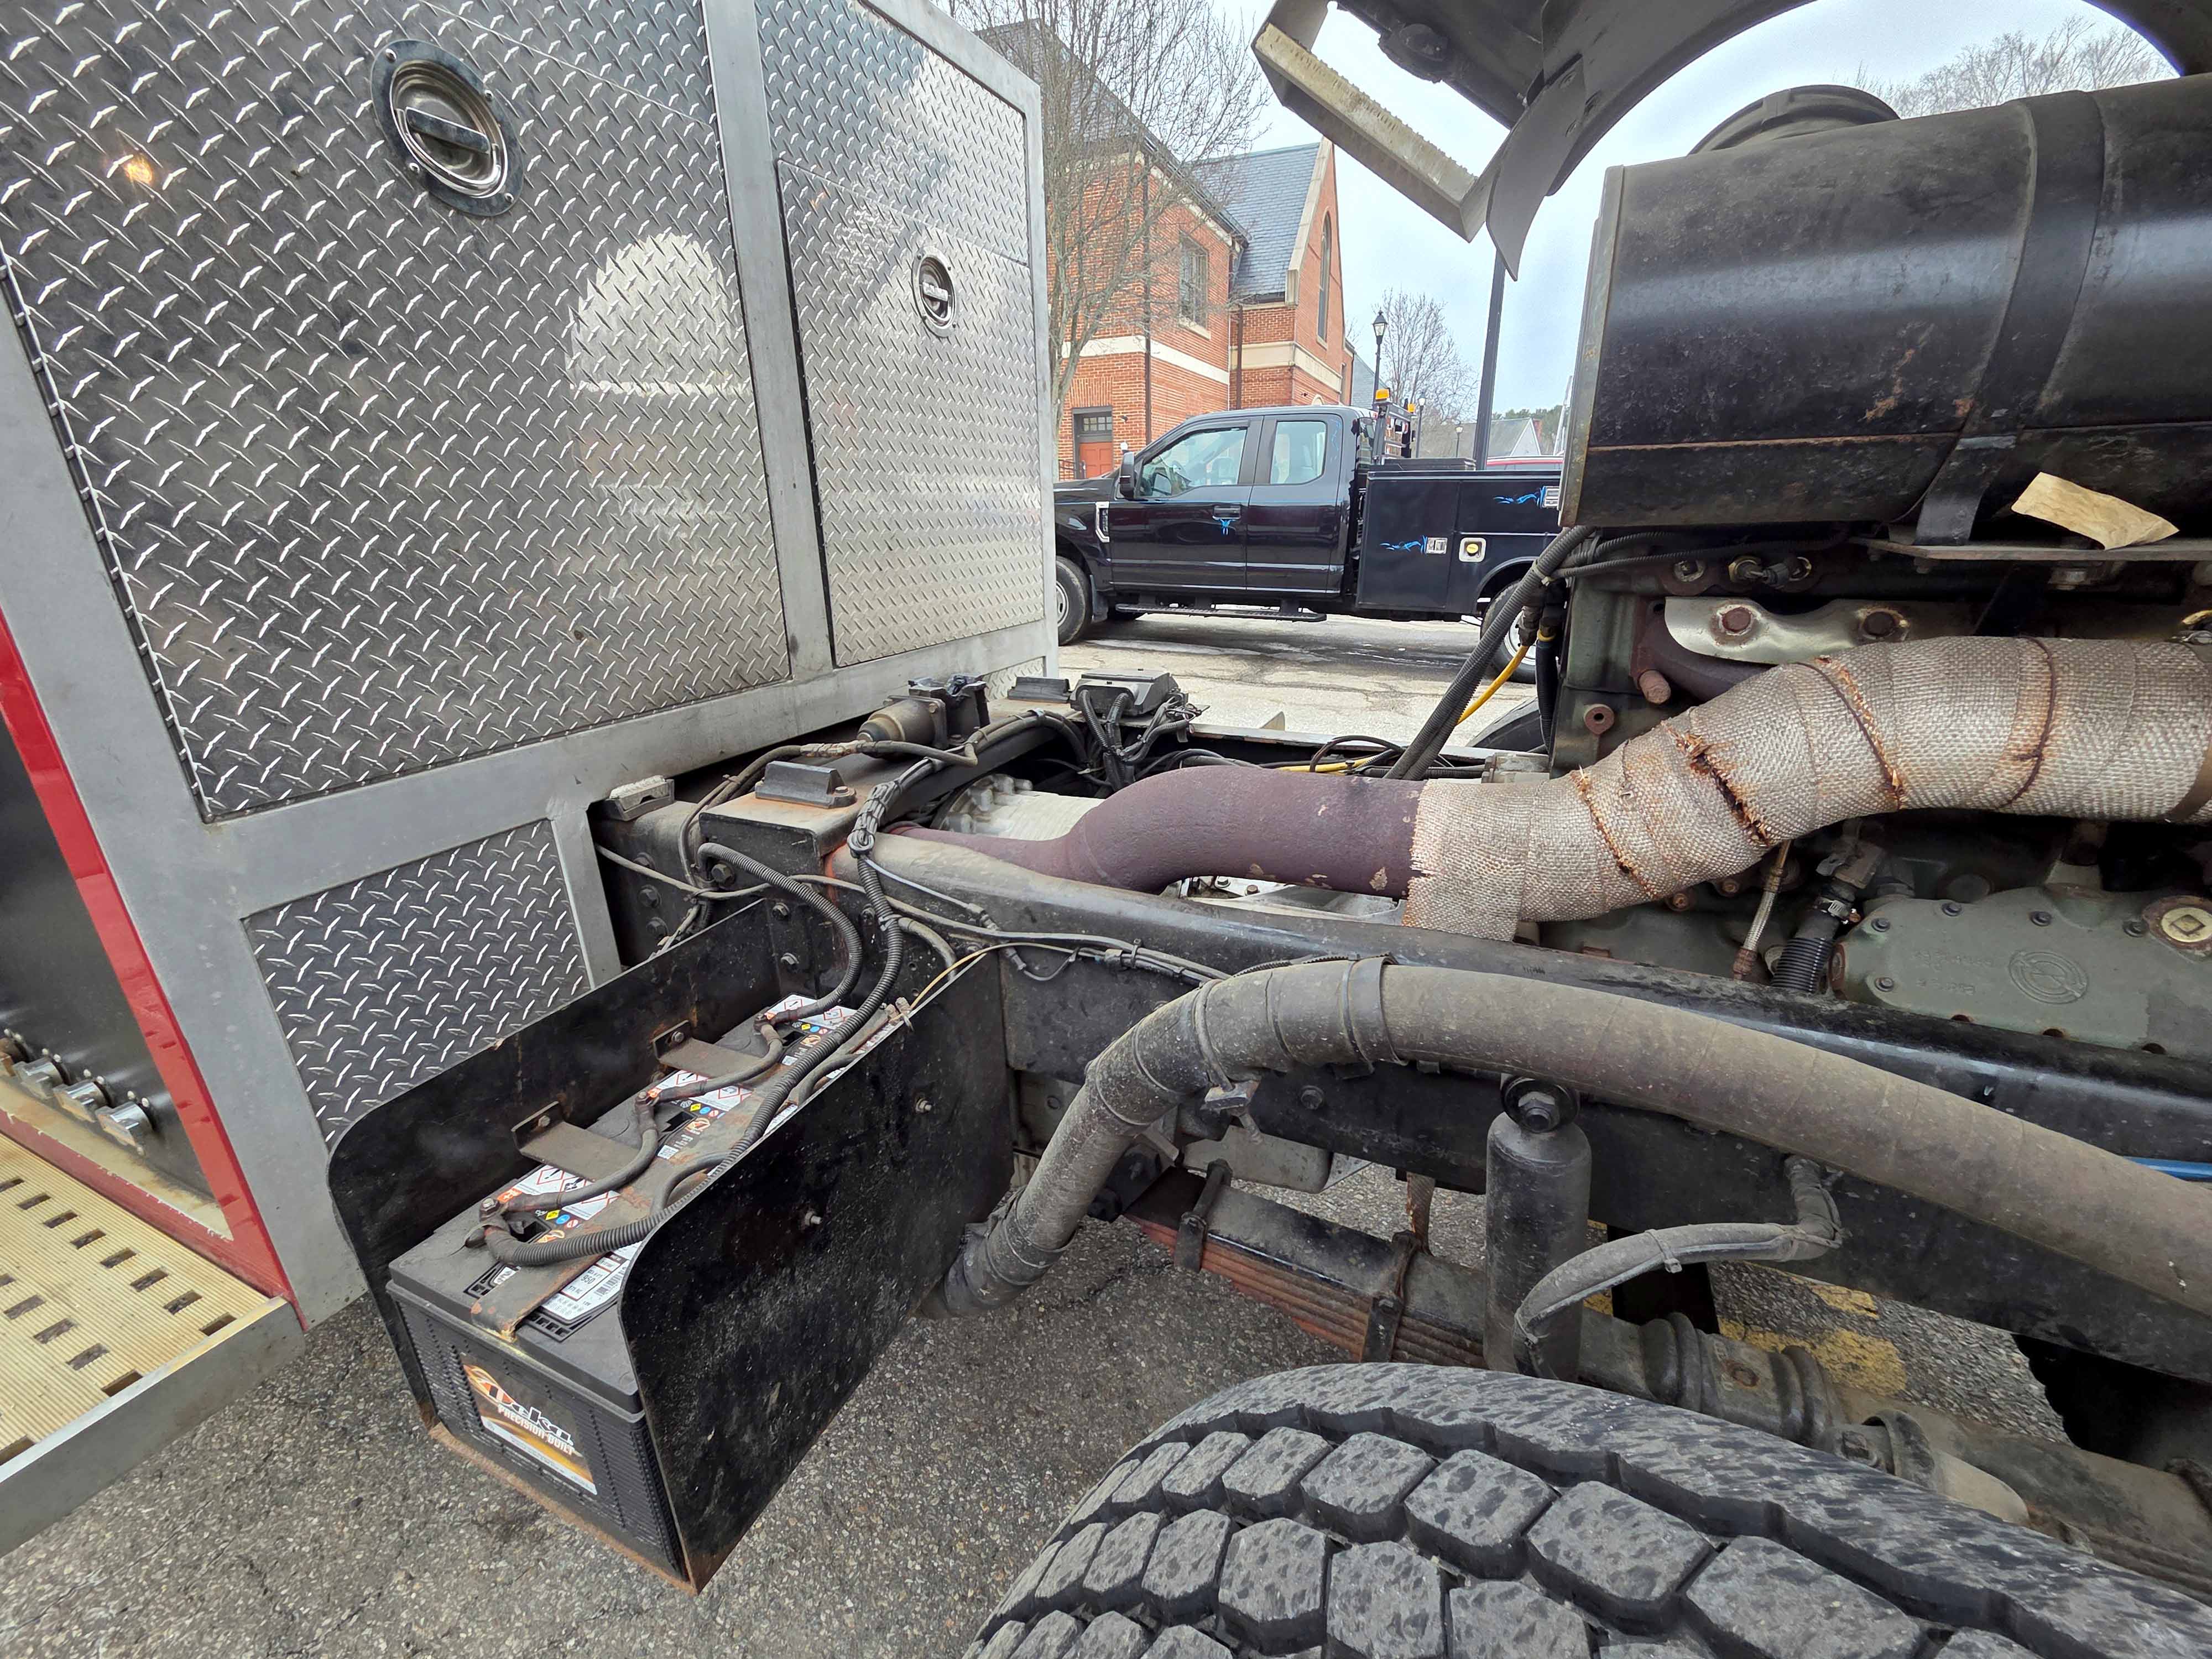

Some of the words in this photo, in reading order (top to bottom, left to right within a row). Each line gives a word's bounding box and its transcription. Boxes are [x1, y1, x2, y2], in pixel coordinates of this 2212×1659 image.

[581, 1275, 596, 1284] 950
[499, 1405, 545, 1439] PRECISION
[547, 1434, 575, 1455] BUILT
